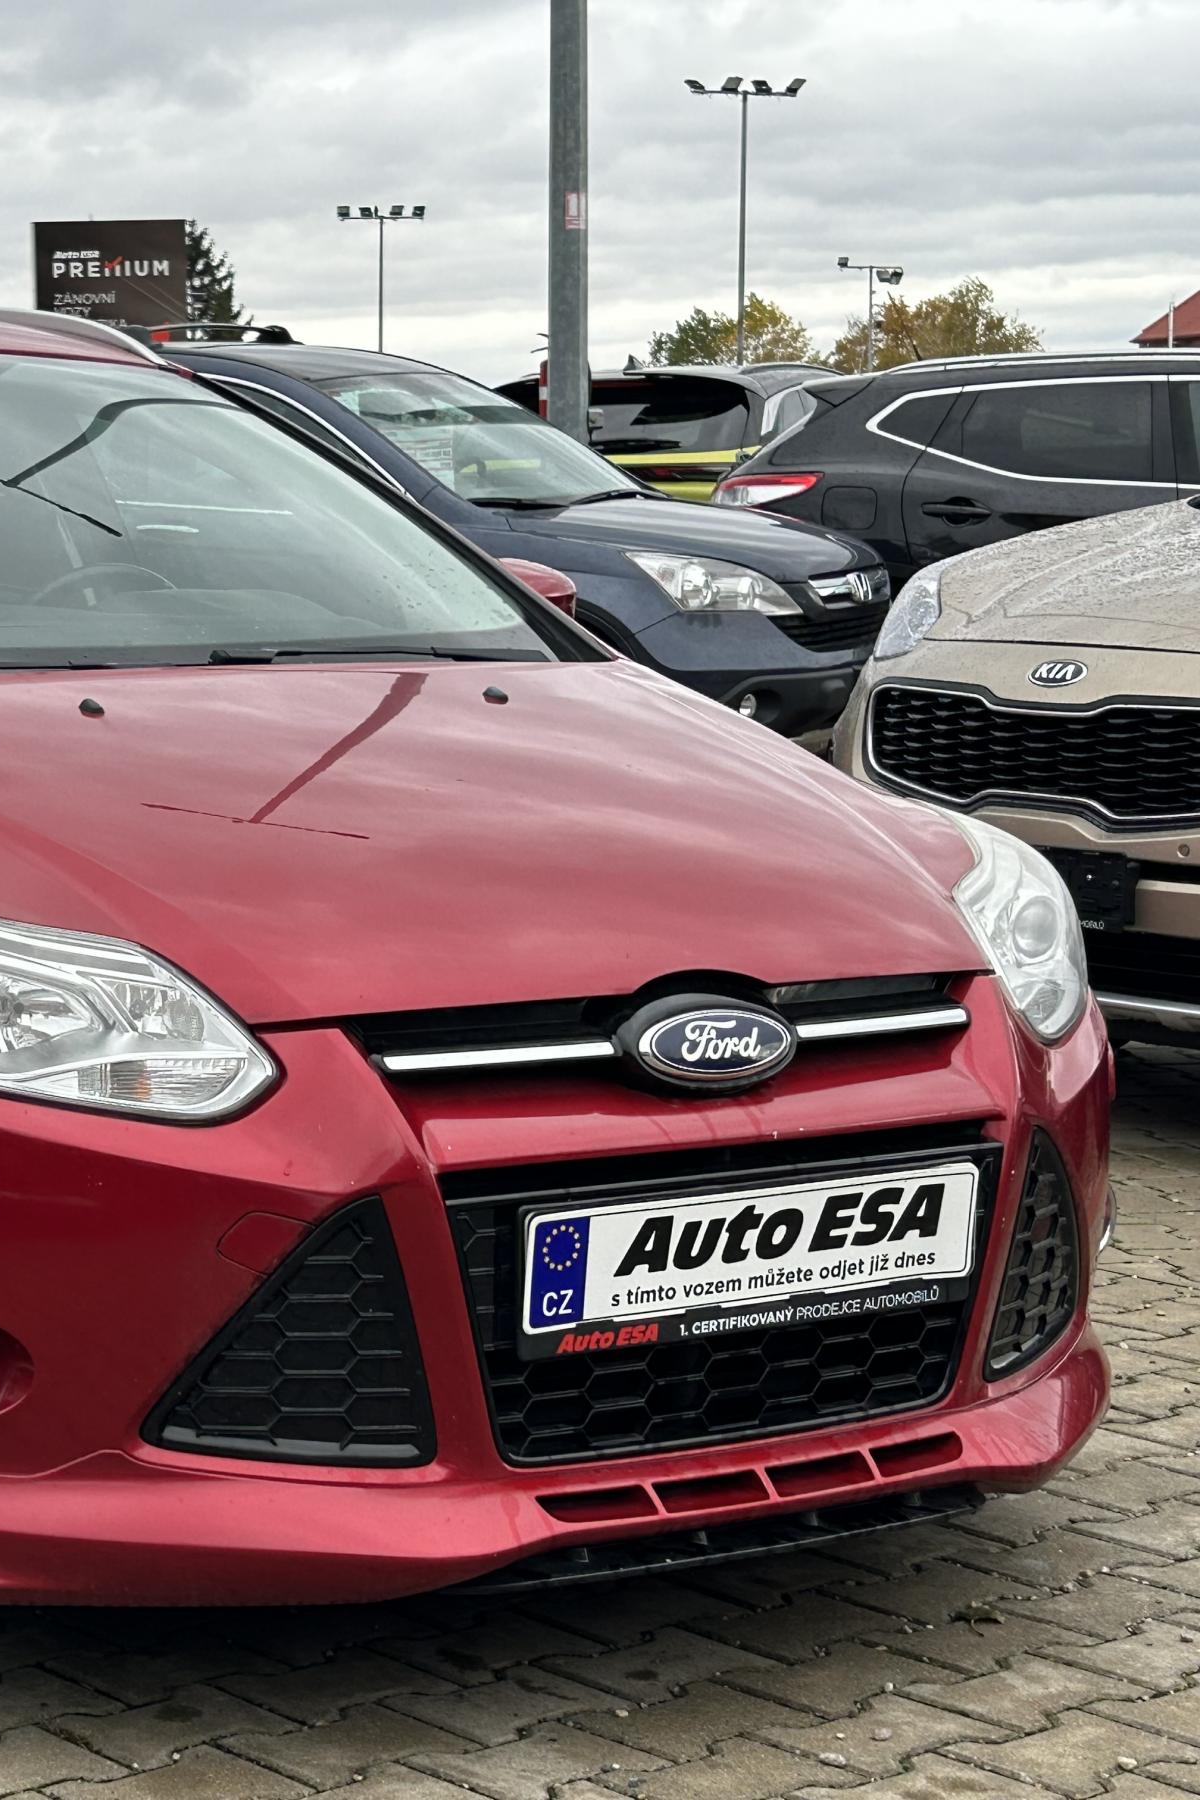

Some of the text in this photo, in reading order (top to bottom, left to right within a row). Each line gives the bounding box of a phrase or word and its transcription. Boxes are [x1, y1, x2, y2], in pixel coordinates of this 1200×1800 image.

[52, 258, 170, 278] PREMIUM
[1034, 663, 1076, 680] KIA
[681, 1020, 761, 1062] Ford
[613, 1183, 945, 1277] Auto ESA
[611, 1251, 936, 1307] s tímto vozem můžete odjet již dnes
[542, 1289, 574, 1317] CZ
[679, 1284, 939, 1336] 1. CERTIFIKOVANÝ PRODEJCE AUTOMOBILŮ
[555, 1323, 660, 1354] Auto ESA
